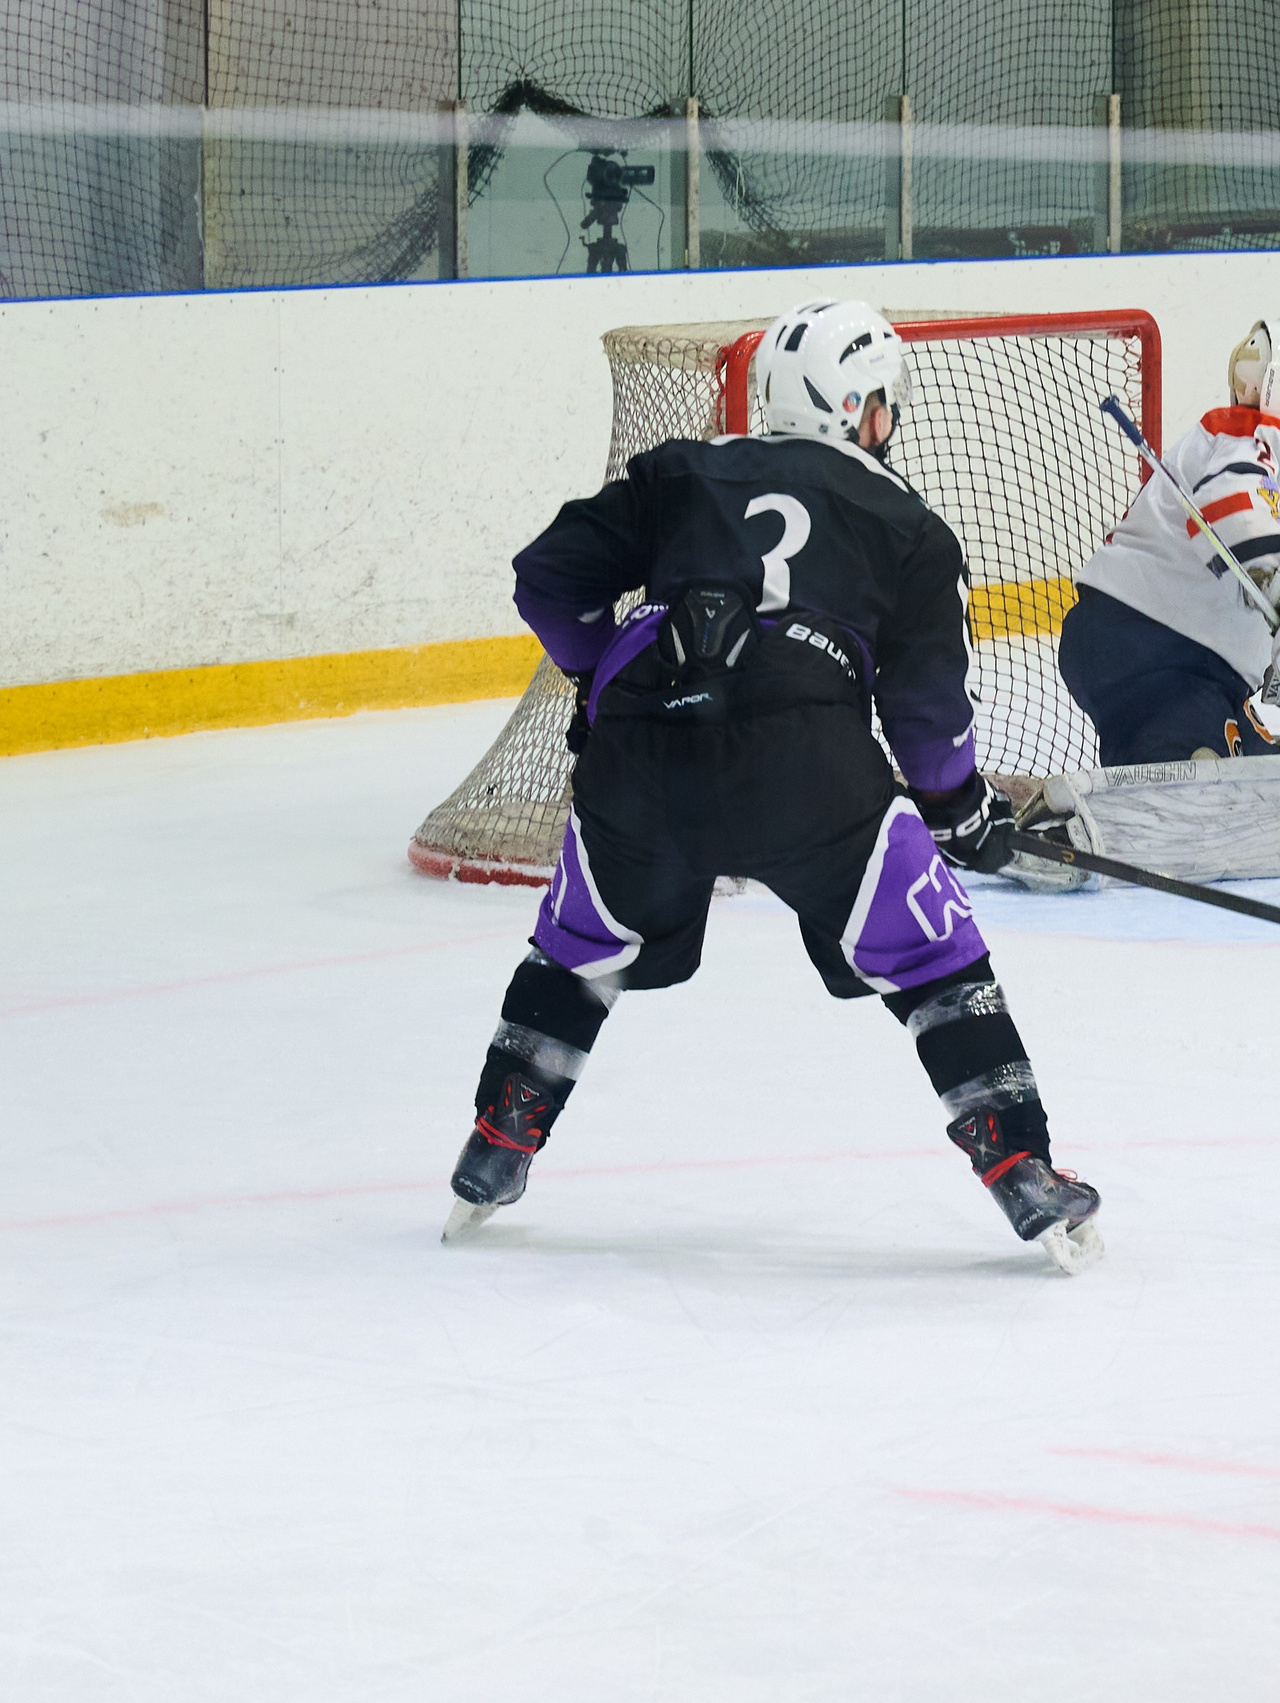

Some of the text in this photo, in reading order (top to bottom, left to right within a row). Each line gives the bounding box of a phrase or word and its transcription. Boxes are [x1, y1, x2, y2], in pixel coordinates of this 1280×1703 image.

[743, 493, 811, 613] 3
[662, 692, 713, 709] VAPOR
[1104, 761, 1197, 787] VAUGHN
